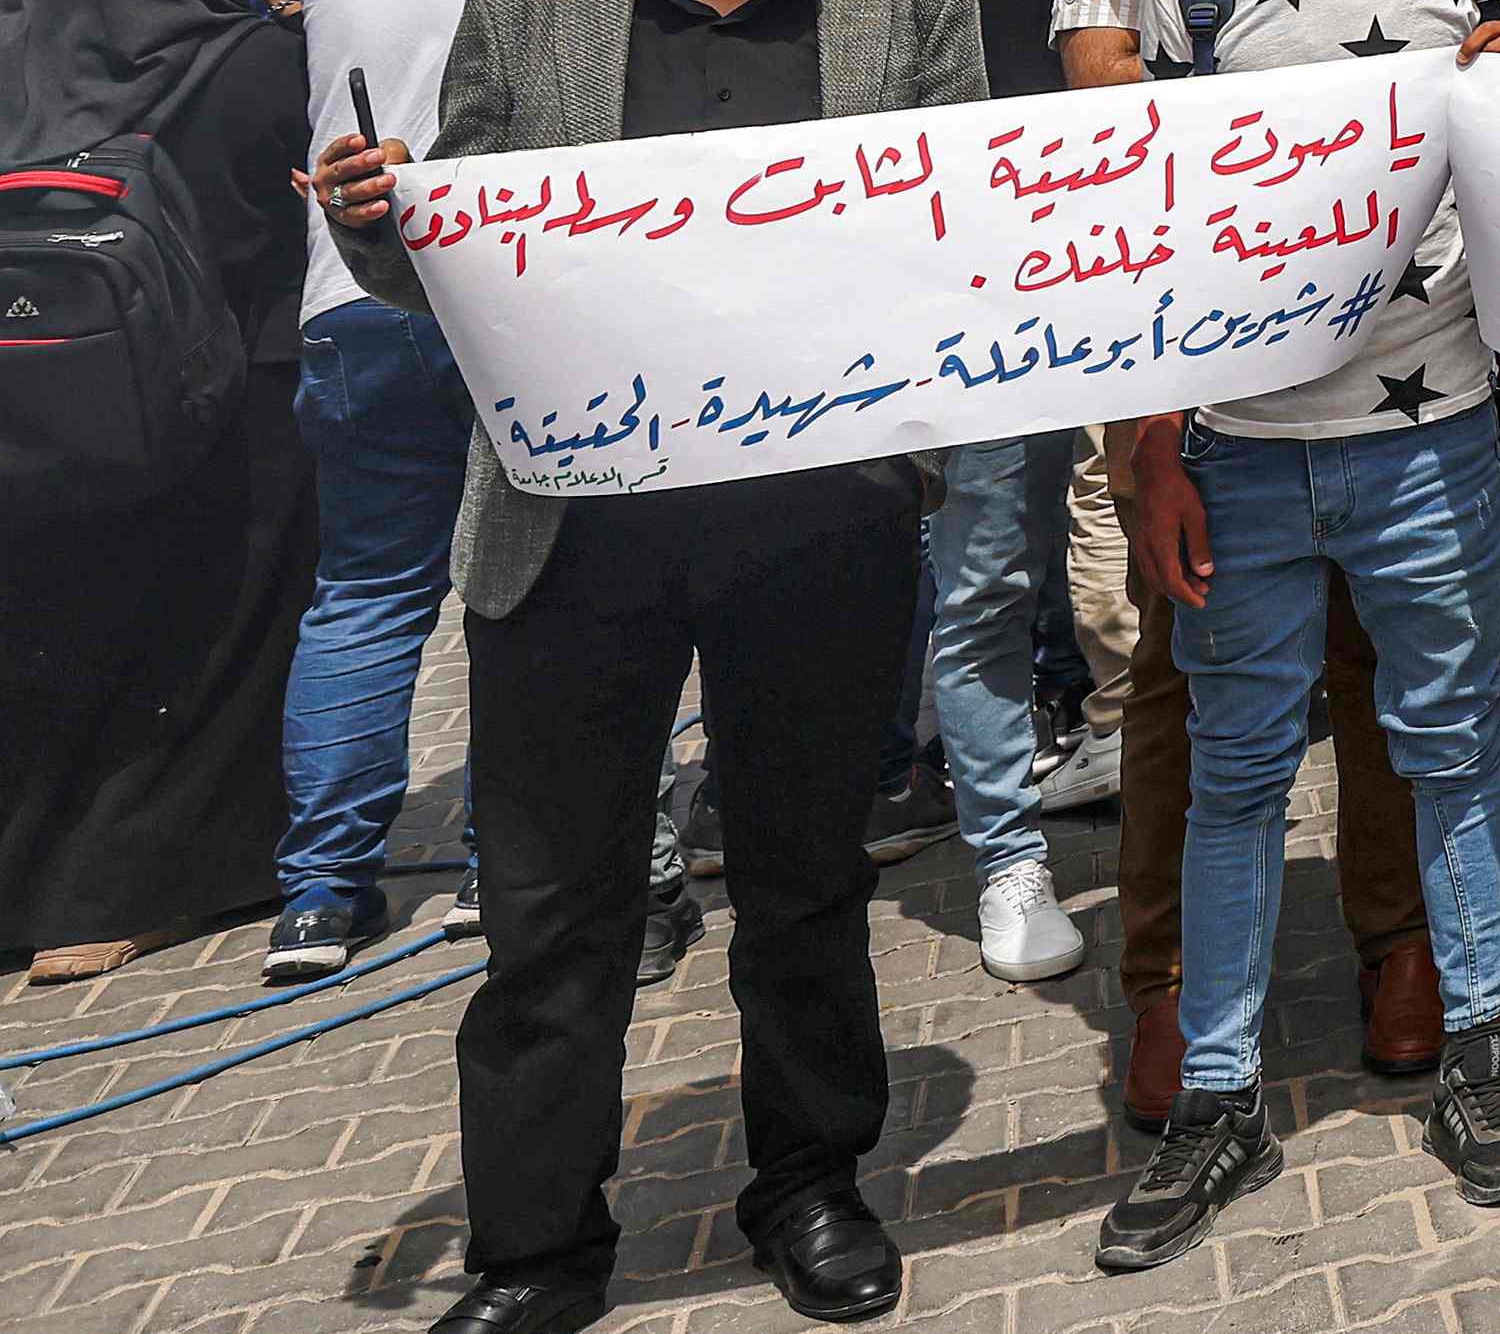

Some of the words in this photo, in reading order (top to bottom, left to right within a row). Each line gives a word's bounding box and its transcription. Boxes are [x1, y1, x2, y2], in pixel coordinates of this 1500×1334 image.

[986, 98, 1176, 224] الحقيقة
[1210, 109, 1365, 189] صوت
[1388, 80, 1426, 173] يا
[399, 175, 552, 278] البنادق
[542, 169, 696, 242] وسط
[725, 131, 947, 243] الثابت
[1205, 189, 1400, 283] اللعينة
